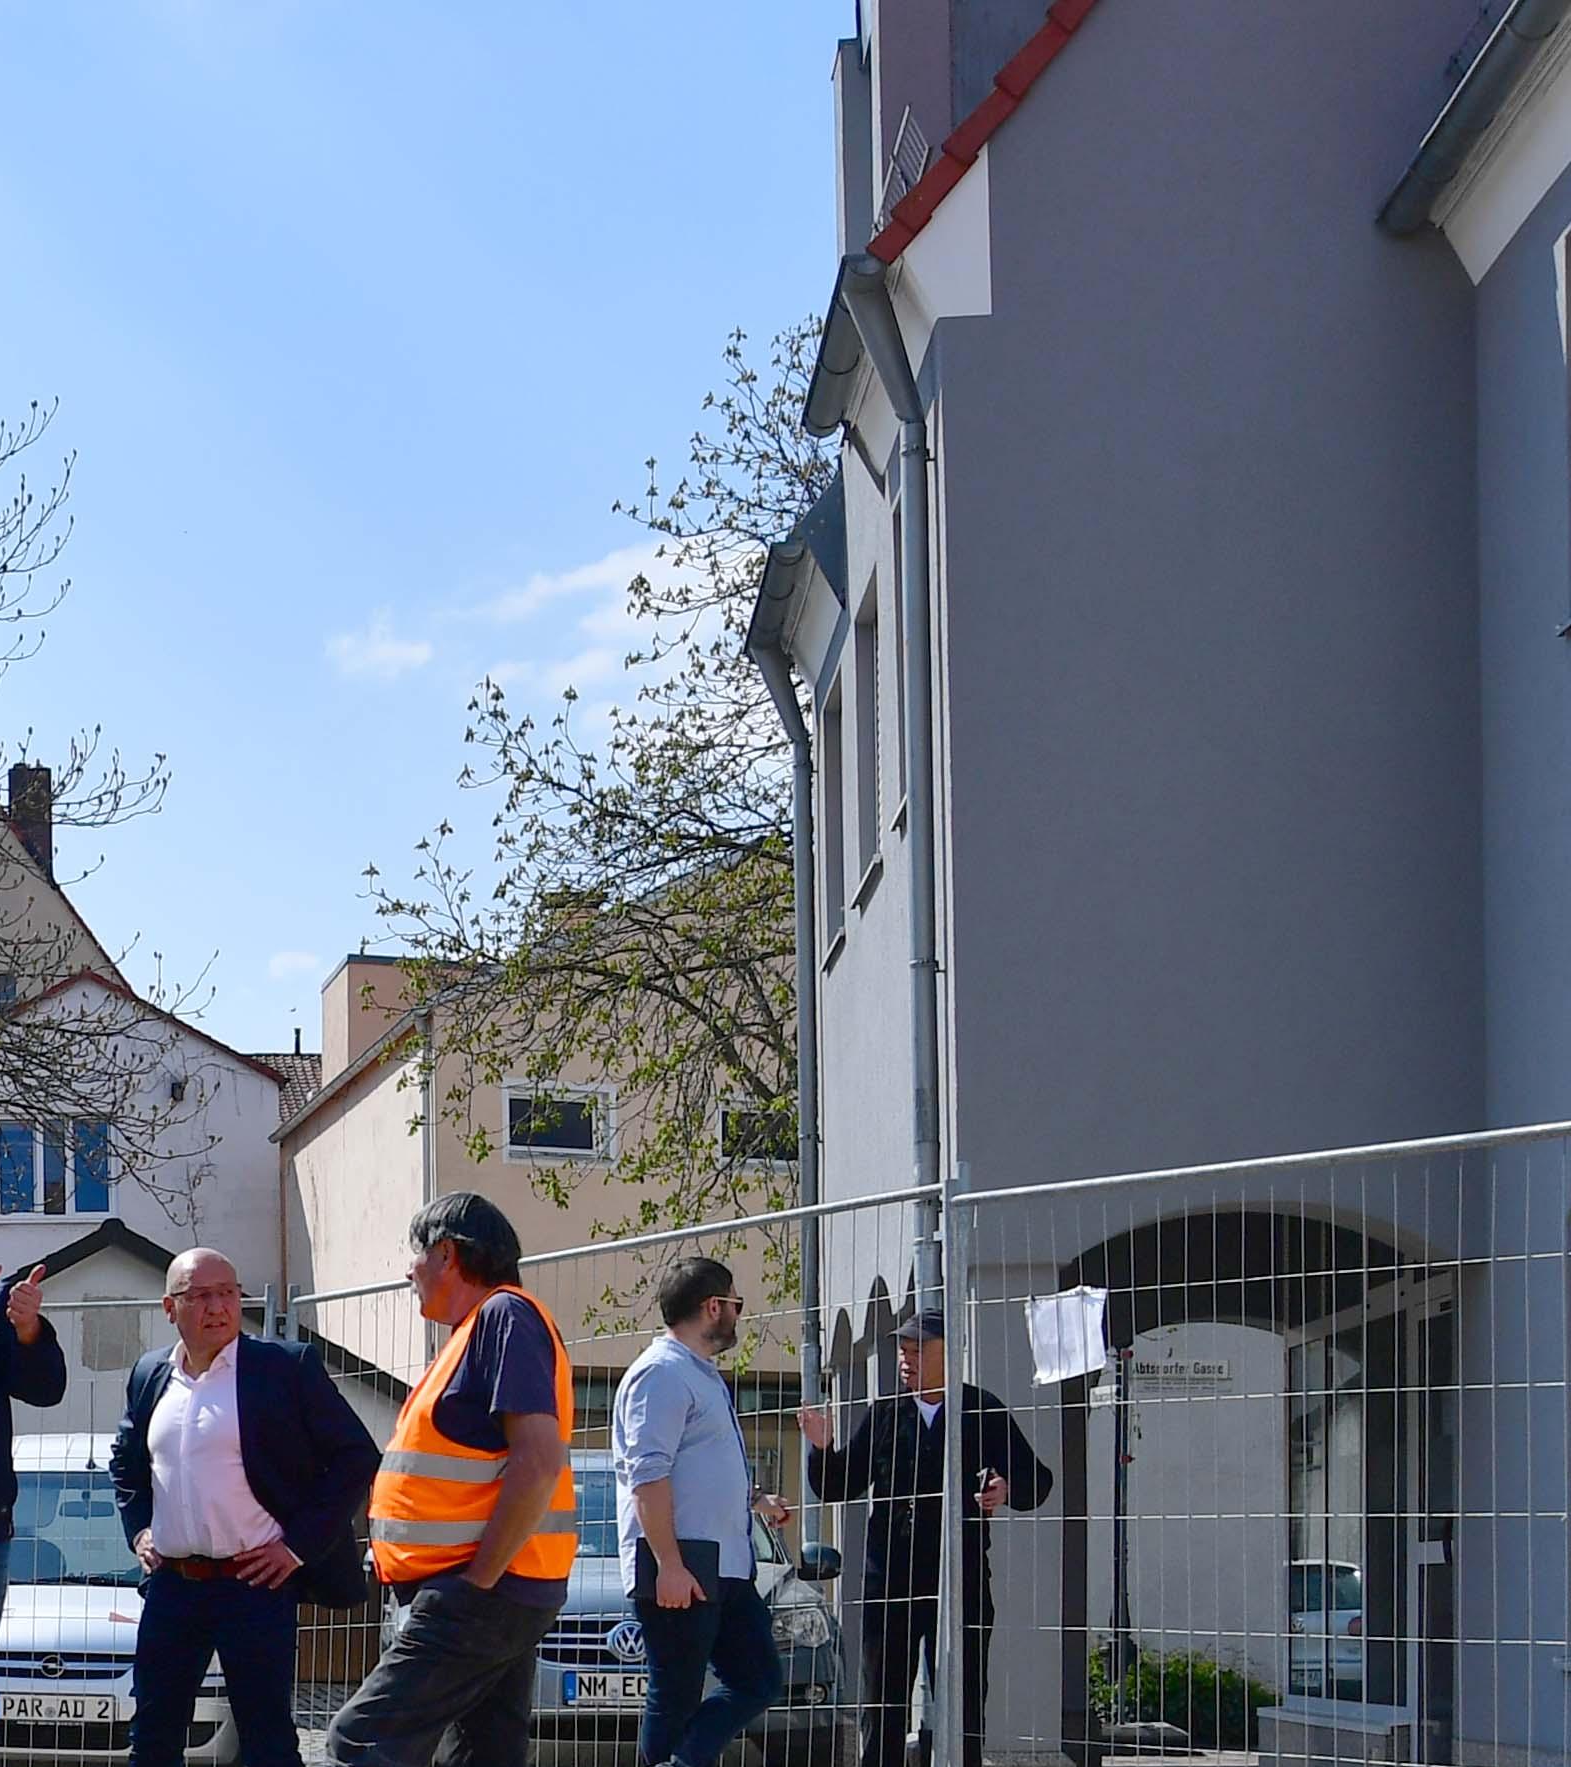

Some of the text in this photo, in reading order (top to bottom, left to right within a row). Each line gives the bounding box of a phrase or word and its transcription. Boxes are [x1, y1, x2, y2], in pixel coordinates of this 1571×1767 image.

[578, 1676, 607, 1697] NM
[3, 1697, 43, 1718] PAR
[97, 1700, 109, 1719] 2
